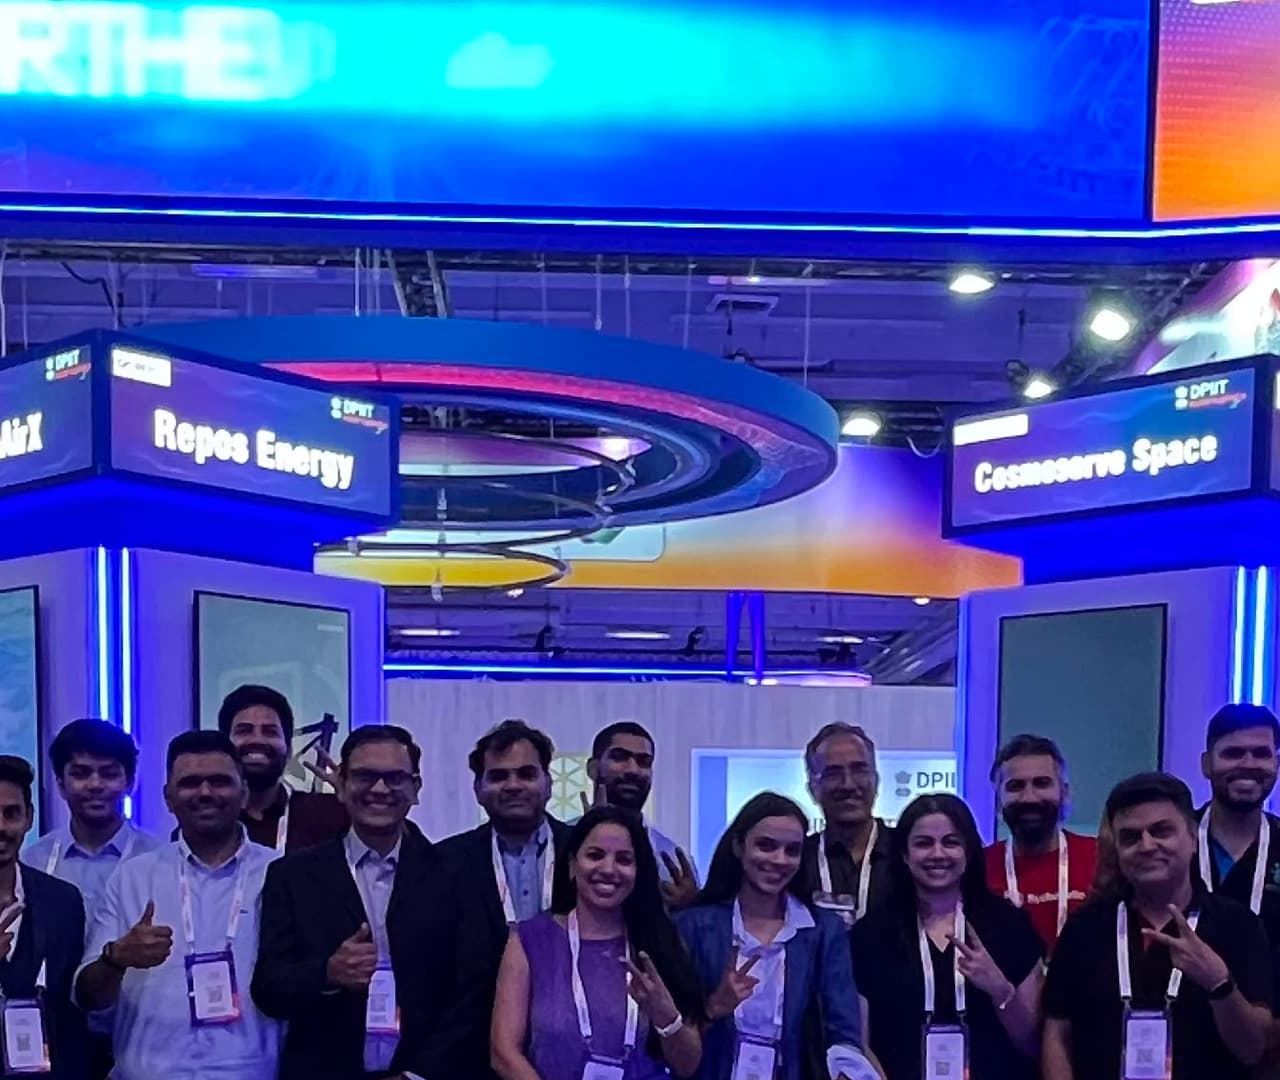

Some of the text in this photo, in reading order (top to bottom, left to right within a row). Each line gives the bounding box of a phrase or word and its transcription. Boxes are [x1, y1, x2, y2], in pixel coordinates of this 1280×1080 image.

[154, 408, 355, 490] Repos Energy
[1132, 434, 1218, 476] Space
